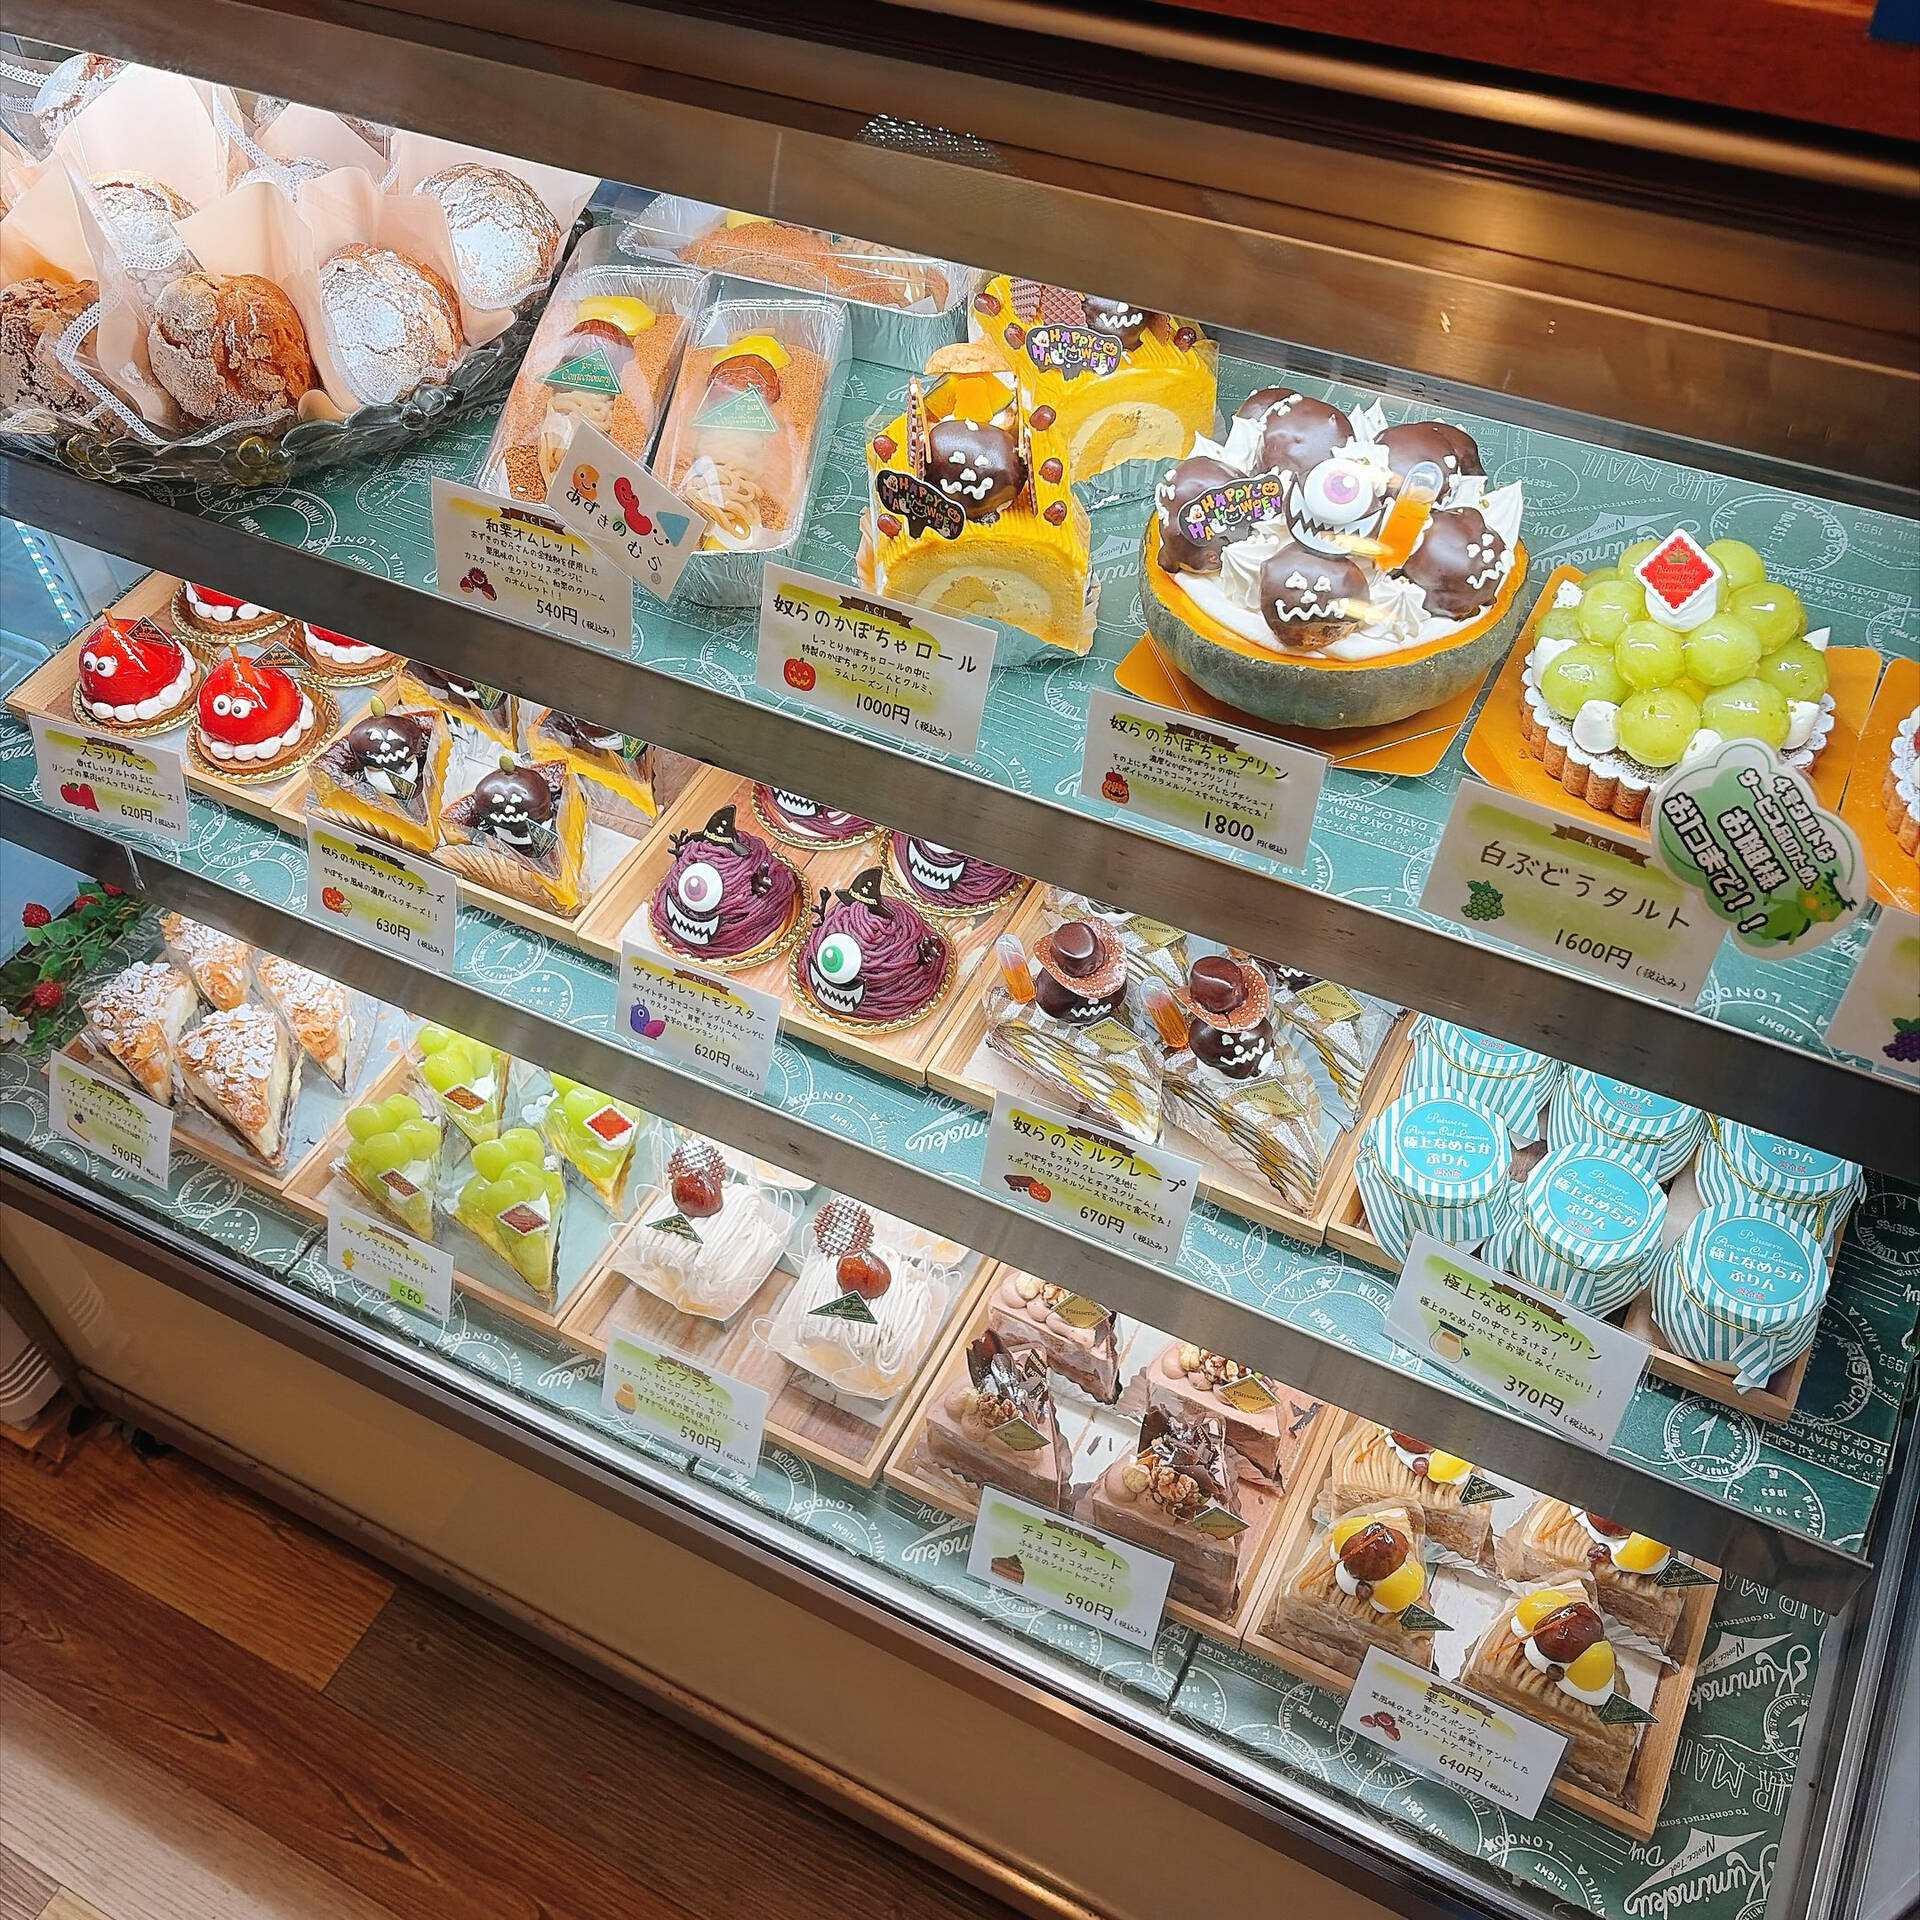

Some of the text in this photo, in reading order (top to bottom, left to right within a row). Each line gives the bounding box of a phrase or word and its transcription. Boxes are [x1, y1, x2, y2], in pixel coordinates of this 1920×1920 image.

[1049, 329, 1096, 350] HAPPY
[898, 477, 943, 509] HAPPY
[1579, 450, 1727, 505] AIR MAIL
[1200, 483, 1253, 513] HAPPY
[485, 518, 581, 557] 和栗オムレット
[566, 486, 663, 572] あずきのむら
[464, 551, 606, 602] カスタード、生クリーム、和栗のクリーム
[485, 547, 583, 583] 栗風味のしっとりスポンジに
[504, 575, 563, 601] のオムレット！！
[536, 600, 578, 626] 540円
[864, 604, 889, 619] A.C.L
[773, 594, 977, 673] 奴らのかぼちゃロール
[801, 643, 933, 696] 特製のかぼちゃクリームとクルミ、
[812, 633, 931, 680] しっとりかぼちゃロールの中に
[834, 668, 899, 697] ラムレーズン！！
[855, 693, 911, 725] 1000円
[80, 745, 147, 771] スラりんご
[1109, 715, 1289, 780] 奴らのかぼちゃプリン
[960, 759, 995, 780] FLIGHT
[121, 804, 153, 823] 620円
[1205, 811, 1255, 842] 1800
[1325, 806, 1359, 822] STAY
[1361, 814, 1393, 833] DAYS
[1375, 808, 1429, 831] DATE OF
[1737, 768, 1821, 890] サービス品のため、
[1773, 776, 1837, 863] 4号タルトは
[1584, 835, 1617, 853] A.C.L
[321, 844, 446, 905] 奴らのかぼちゃバスクチーズ
[1480, 840, 1690, 930] 白ぶどうタルト
[323, 867, 438, 922] かぼちゃ風味の濃厚バスクチーズ！！
[376, 918, 411, 942] 630円
[1554, 929, 1633, 970] 1600円
[633, 965, 767, 1023] ヴァイオレットモンスター
[1312, 994, 1348, 1010] Pâtisserie
[1756, 1013, 1804, 1044] FLIGHT
[694, 1043, 731, 1067] 620円
[1253, 1093, 1290, 1108] Pâtisserie
[829, 1112, 857, 1135] FLIGHT
[111, 1143, 142, 1170] 590円
[1012, 1116, 1187, 1194] 奴らのミルクレープ
[1089, 1133, 1113, 1149] A.C.L
[1403, 1136, 1492, 1156] 極上なめらか
[1771, 1143, 1817, 1165] ぷりん
[1049, 1151, 1138, 1192] もっちりクレープ生地に
[1426, 1152, 1471, 1168] ぷりん
[1007, 1154, 1172, 1228] スポイトのカラメルソースをかけて食べてね！
[1024, 1151, 1159, 1211] かぼちゃクリームとチョコクリーム！
[1553, 1177, 1638, 1229] 極上なめらか
[1564, 1202, 1607, 1232] ぷりん
[1080, 1205, 1125, 1234] 670円
[340, 1222, 438, 1275] シャインマスカットタルト
[1708, 1245, 1805, 1284] 極上なめらか
[1728, 1270, 1777, 1293] ぷりん
[1442, 1272, 1603, 1362] 極上なめらかプリン
[1514, 1292, 1542, 1313] A.C.L
[1419, 1295, 1603, 1400] 極上のなめらかさをお楽しみください！！
[1471, 1309, 1558, 1361] 口の中でとろける！
[654, 1359, 714, 1393] モンブラン
[1503, 1374, 1565, 1417] 370円
[680, 1425, 722, 1454] 590円
[831, 1520, 858, 1542] FLIGHT
[1021, 1523, 1123, 1572] チョコショート
[1018, 1548, 1113, 1593] クルミのショートケーキ！
[1064, 1591, 1114, 1623] 590円
[1712, 1613, 1763, 1629] construct
[1424, 1690, 1492, 1729] 栗ショート
[1398, 1714, 1492, 1768] 栗のショートケーキ！！
[1438, 1753, 1484, 1784] 640円
[1682, 1809, 1734, 1825] construct
[1628, 1841, 1665, 1868] Diy
[1669, 1835, 1716, 1878] Novice Tool
[1533, 1861, 1569, 1893] FLIGHT
